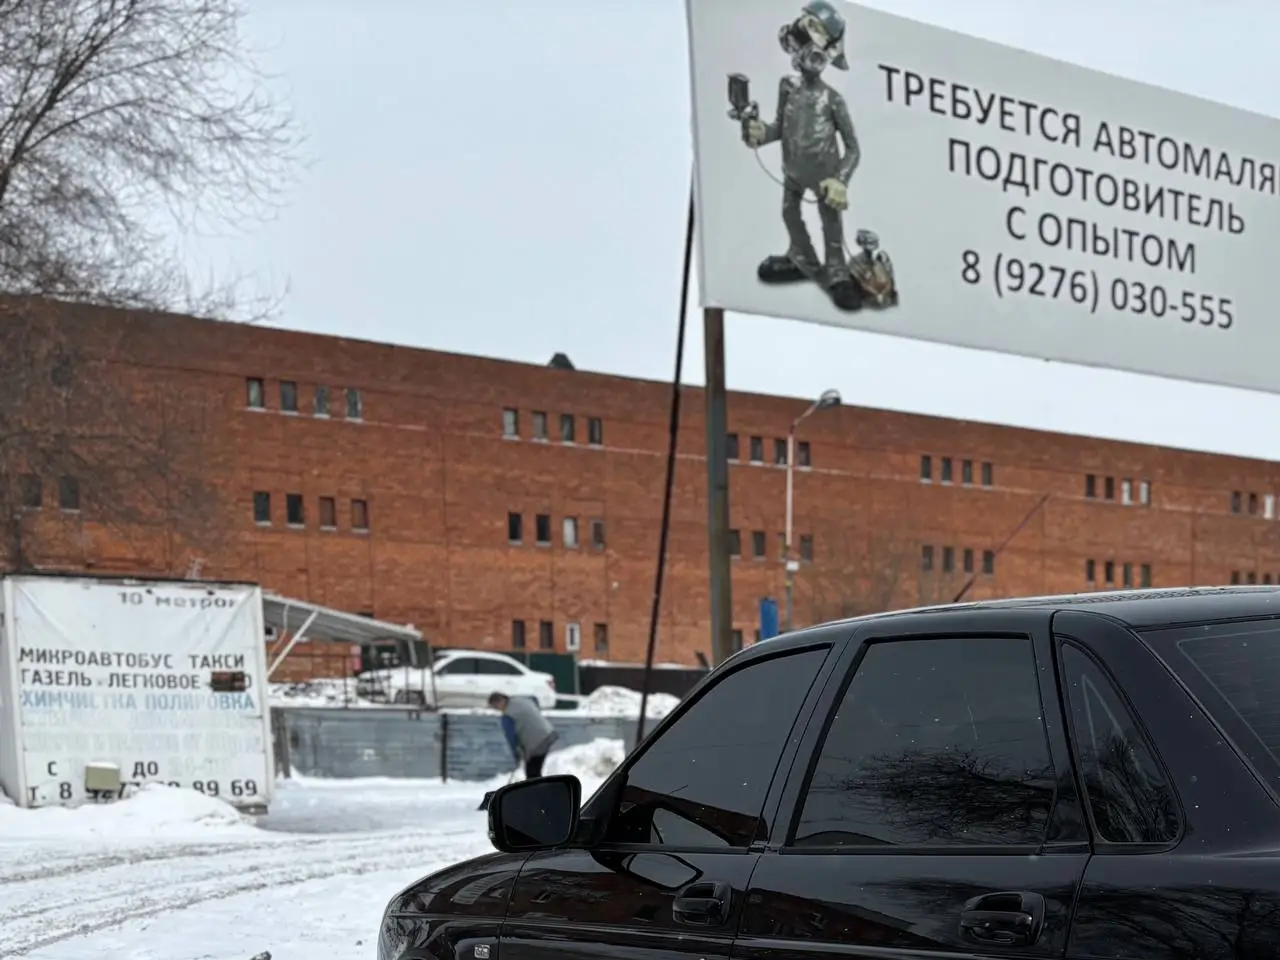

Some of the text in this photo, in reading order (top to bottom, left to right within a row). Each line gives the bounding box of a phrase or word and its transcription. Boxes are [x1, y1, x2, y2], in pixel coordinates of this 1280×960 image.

[877, 63, 1080, 148] ТРЕБУЕТСЯ
[948, 137, 1245, 235] ПОДГОТОВИТЕЛЬ
[1006, 206, 1195, 274] С ОПЫТОМ
[961, 249, 1233, 329] 8 (9276) 030-555
[118, 591, 143, 606] 10
[20, 647, 245, 669] МИКРОАВТОБУС ТАКСИ
[108, 672, 201, 690] ЛЕГКОВОЕ
[22, 689, 255, 711] ХИМЧИСТКА ПОЛИРОВКА
[132, 761, 159, 779] ДО
[60, 781, 72, 800] 8
[231, 779, 258, 797] 69
